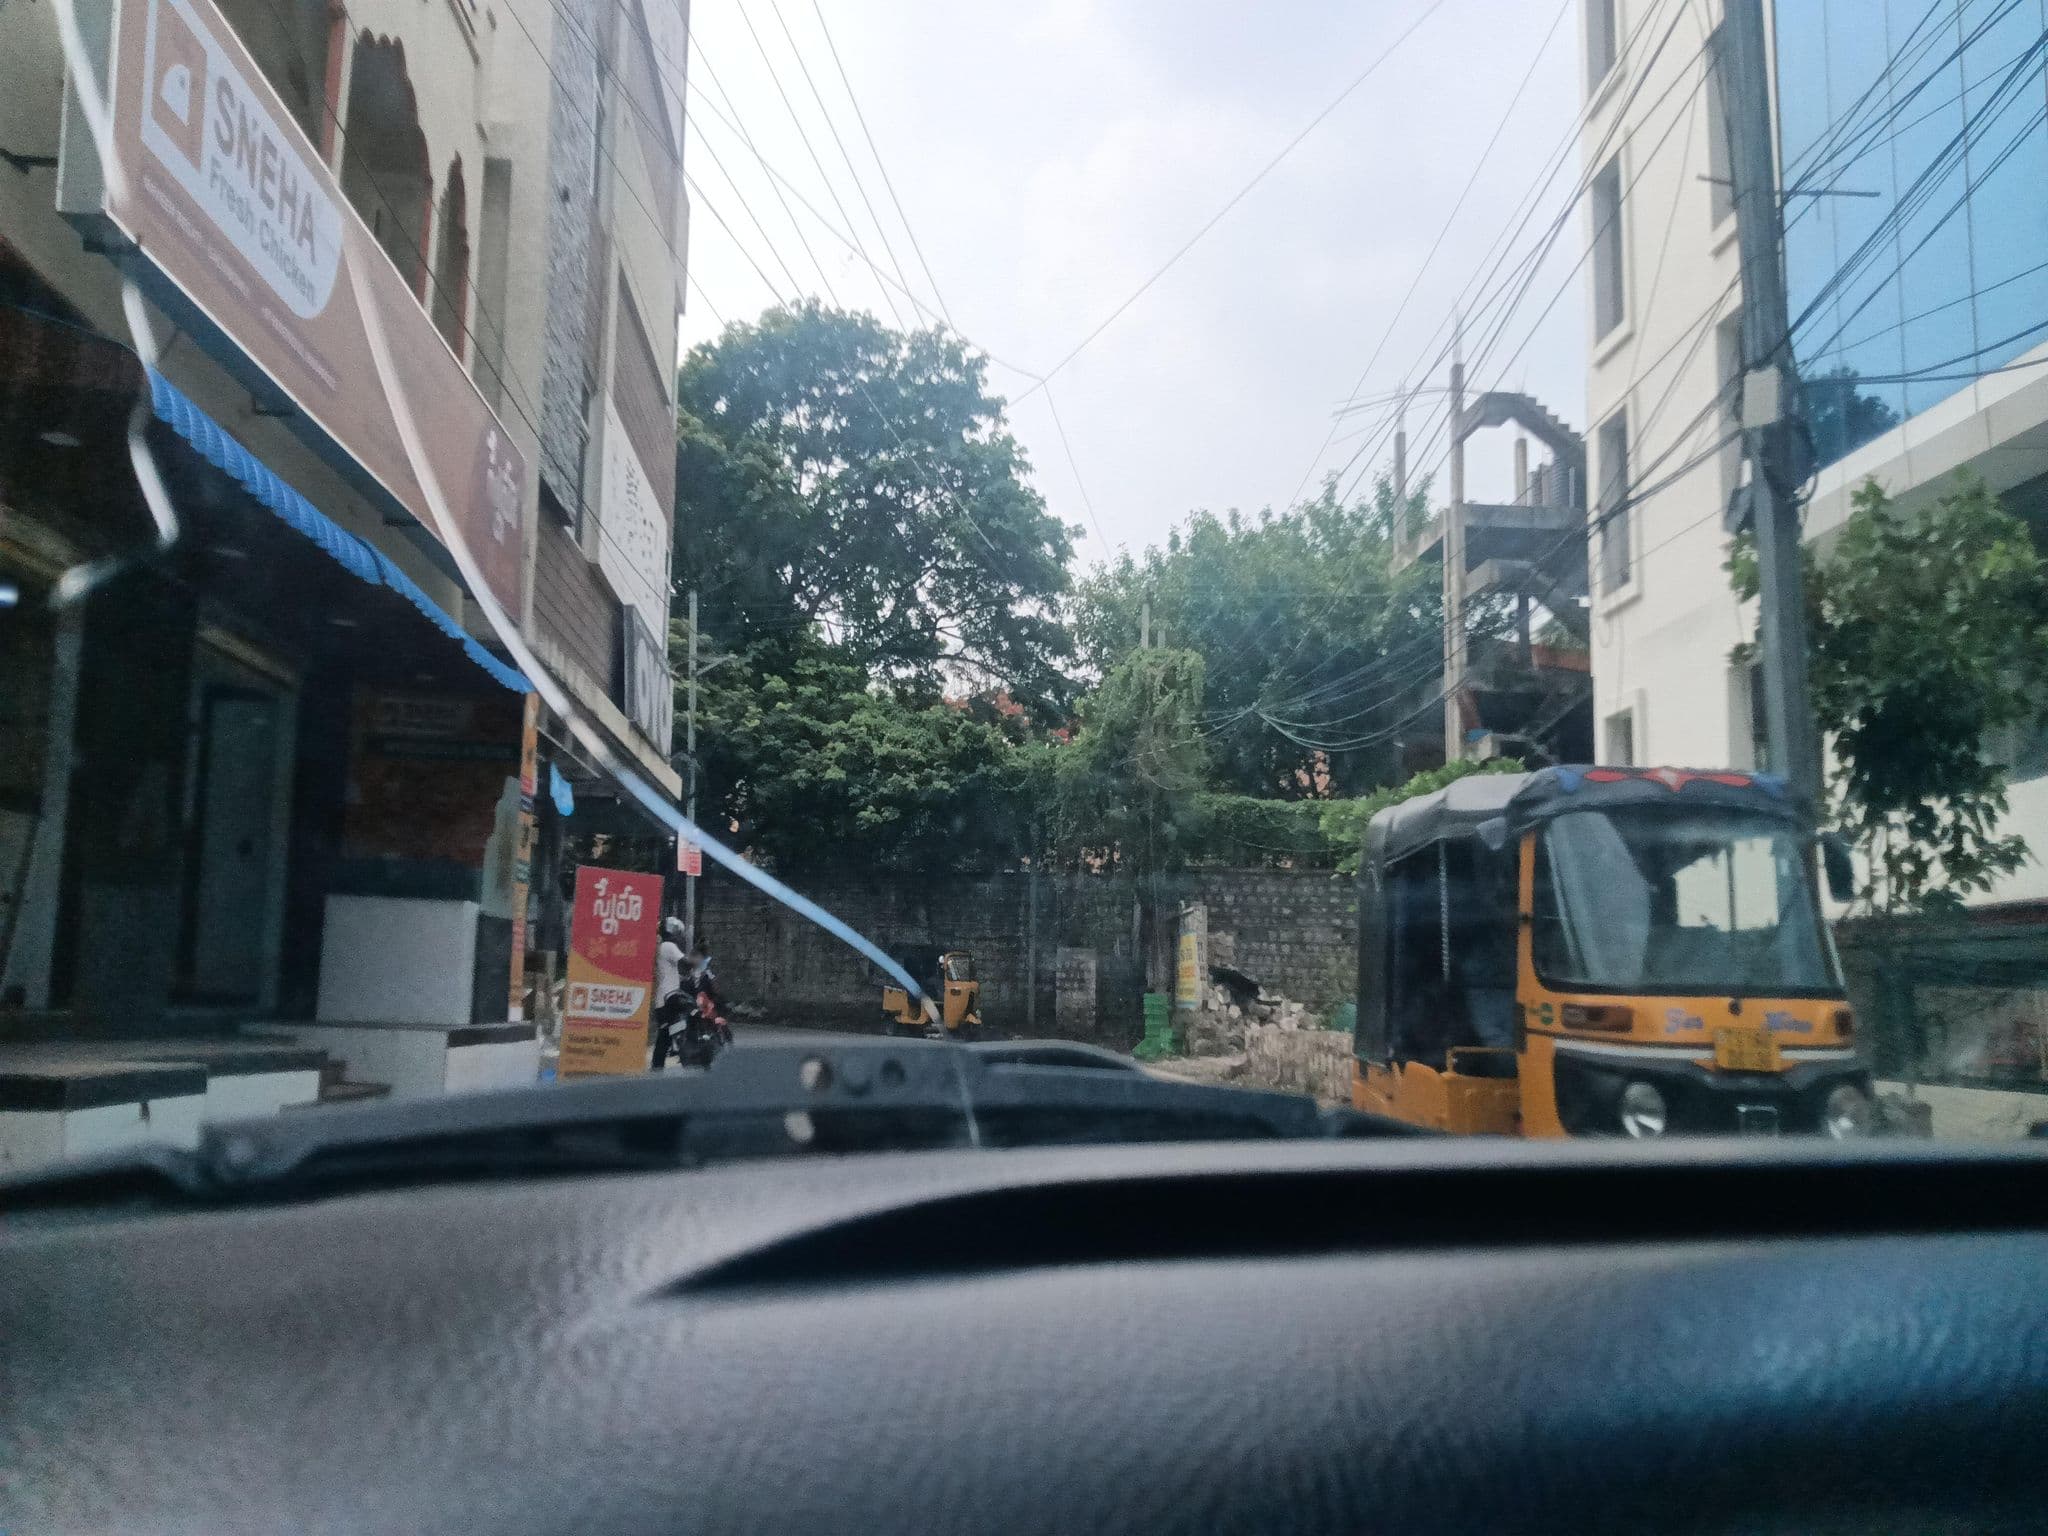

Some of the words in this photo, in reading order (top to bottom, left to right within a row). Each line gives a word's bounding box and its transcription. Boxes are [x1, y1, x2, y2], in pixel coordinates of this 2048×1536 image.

[209, 154, 255, 236] Fresh
[214, 76, 317, 265] SNEHA
[591, 988, 633, 1006] SNEHA
